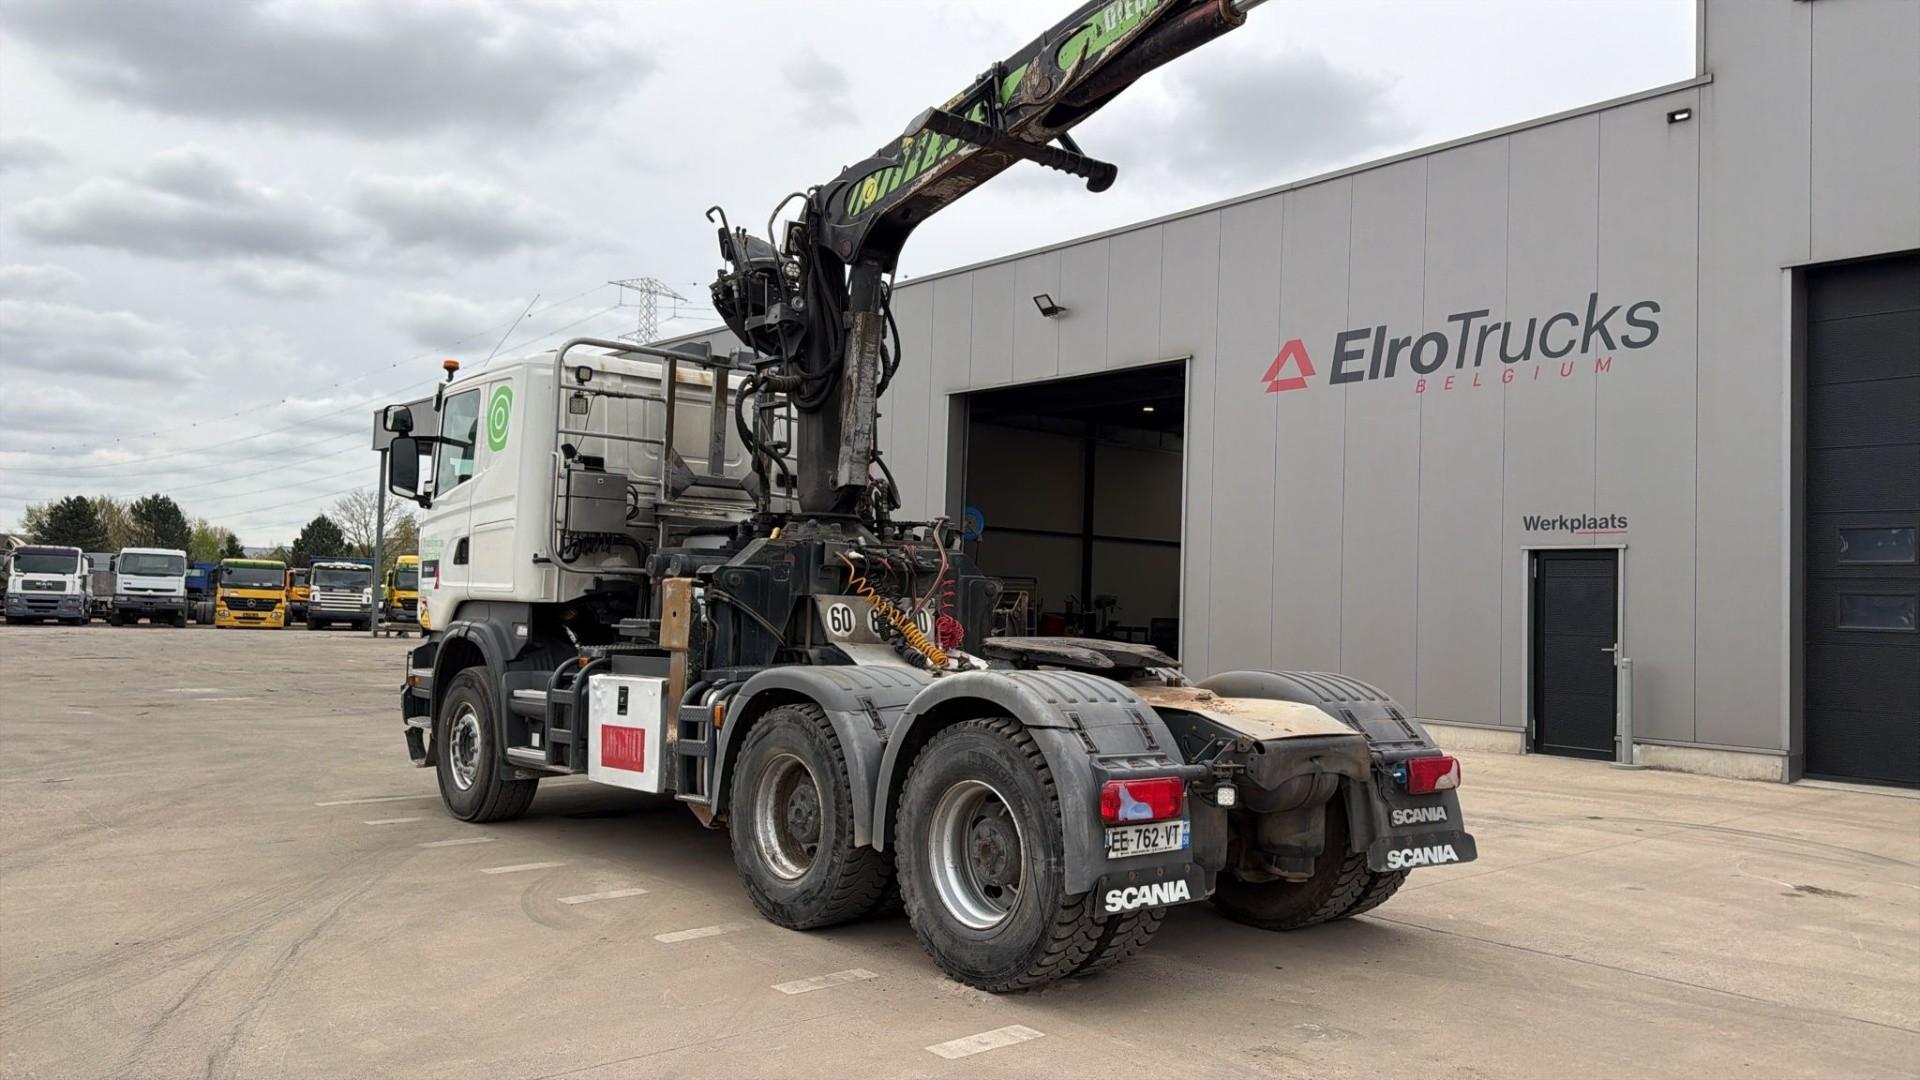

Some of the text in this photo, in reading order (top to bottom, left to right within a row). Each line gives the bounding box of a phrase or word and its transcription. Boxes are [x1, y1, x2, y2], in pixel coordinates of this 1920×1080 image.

[1329, 292, 1661, 385] ElroTrucks
[1415, 356, 1613, 394] BELGIUM
[1523, 513, 1628, 533] Werkplaats
[830, 606, 852, 632] 60
[1392, 806, 1448, 825] SCANIA
[1387, 844, 1459, 869] SCANIA
[1104, 879, 1191, 912] SCANIA
